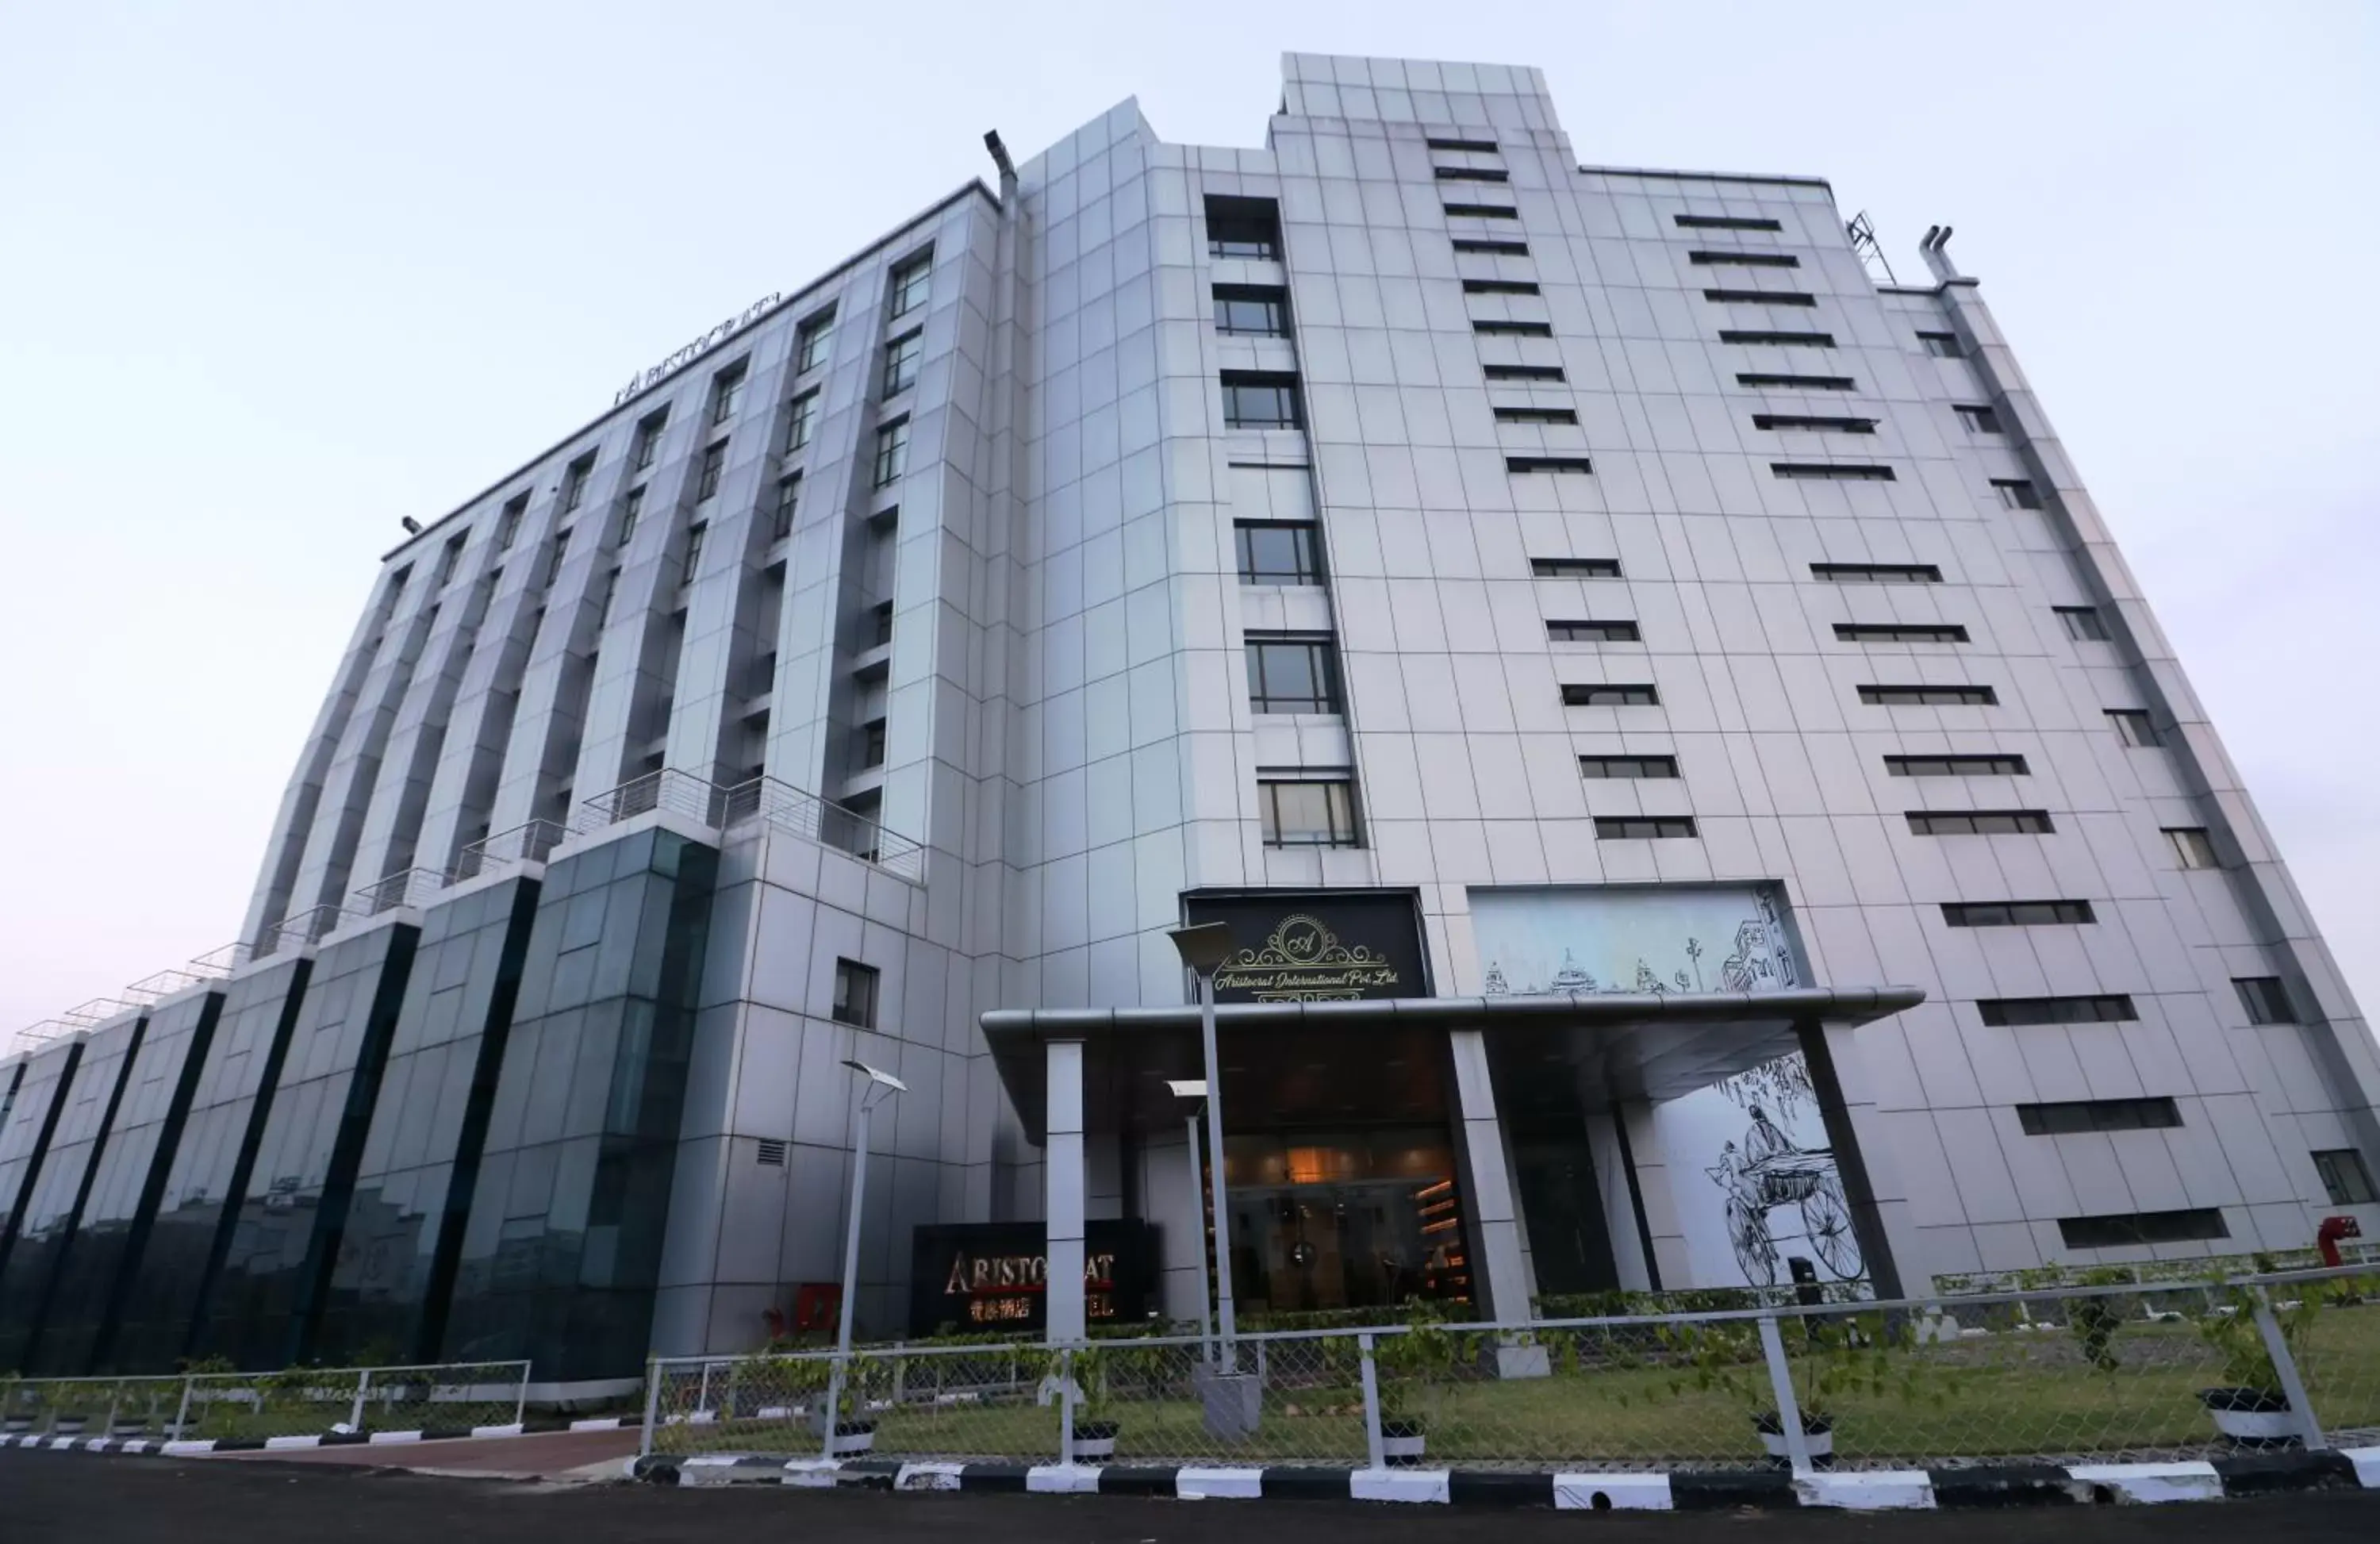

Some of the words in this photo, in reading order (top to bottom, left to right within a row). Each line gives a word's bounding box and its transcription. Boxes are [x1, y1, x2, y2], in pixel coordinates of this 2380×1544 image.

[1215, 973, 1274, 991] Aristocrat
[1275, 971, 1348, 989] International
[944, 1250, 1115, 1295] ARISTOAT
